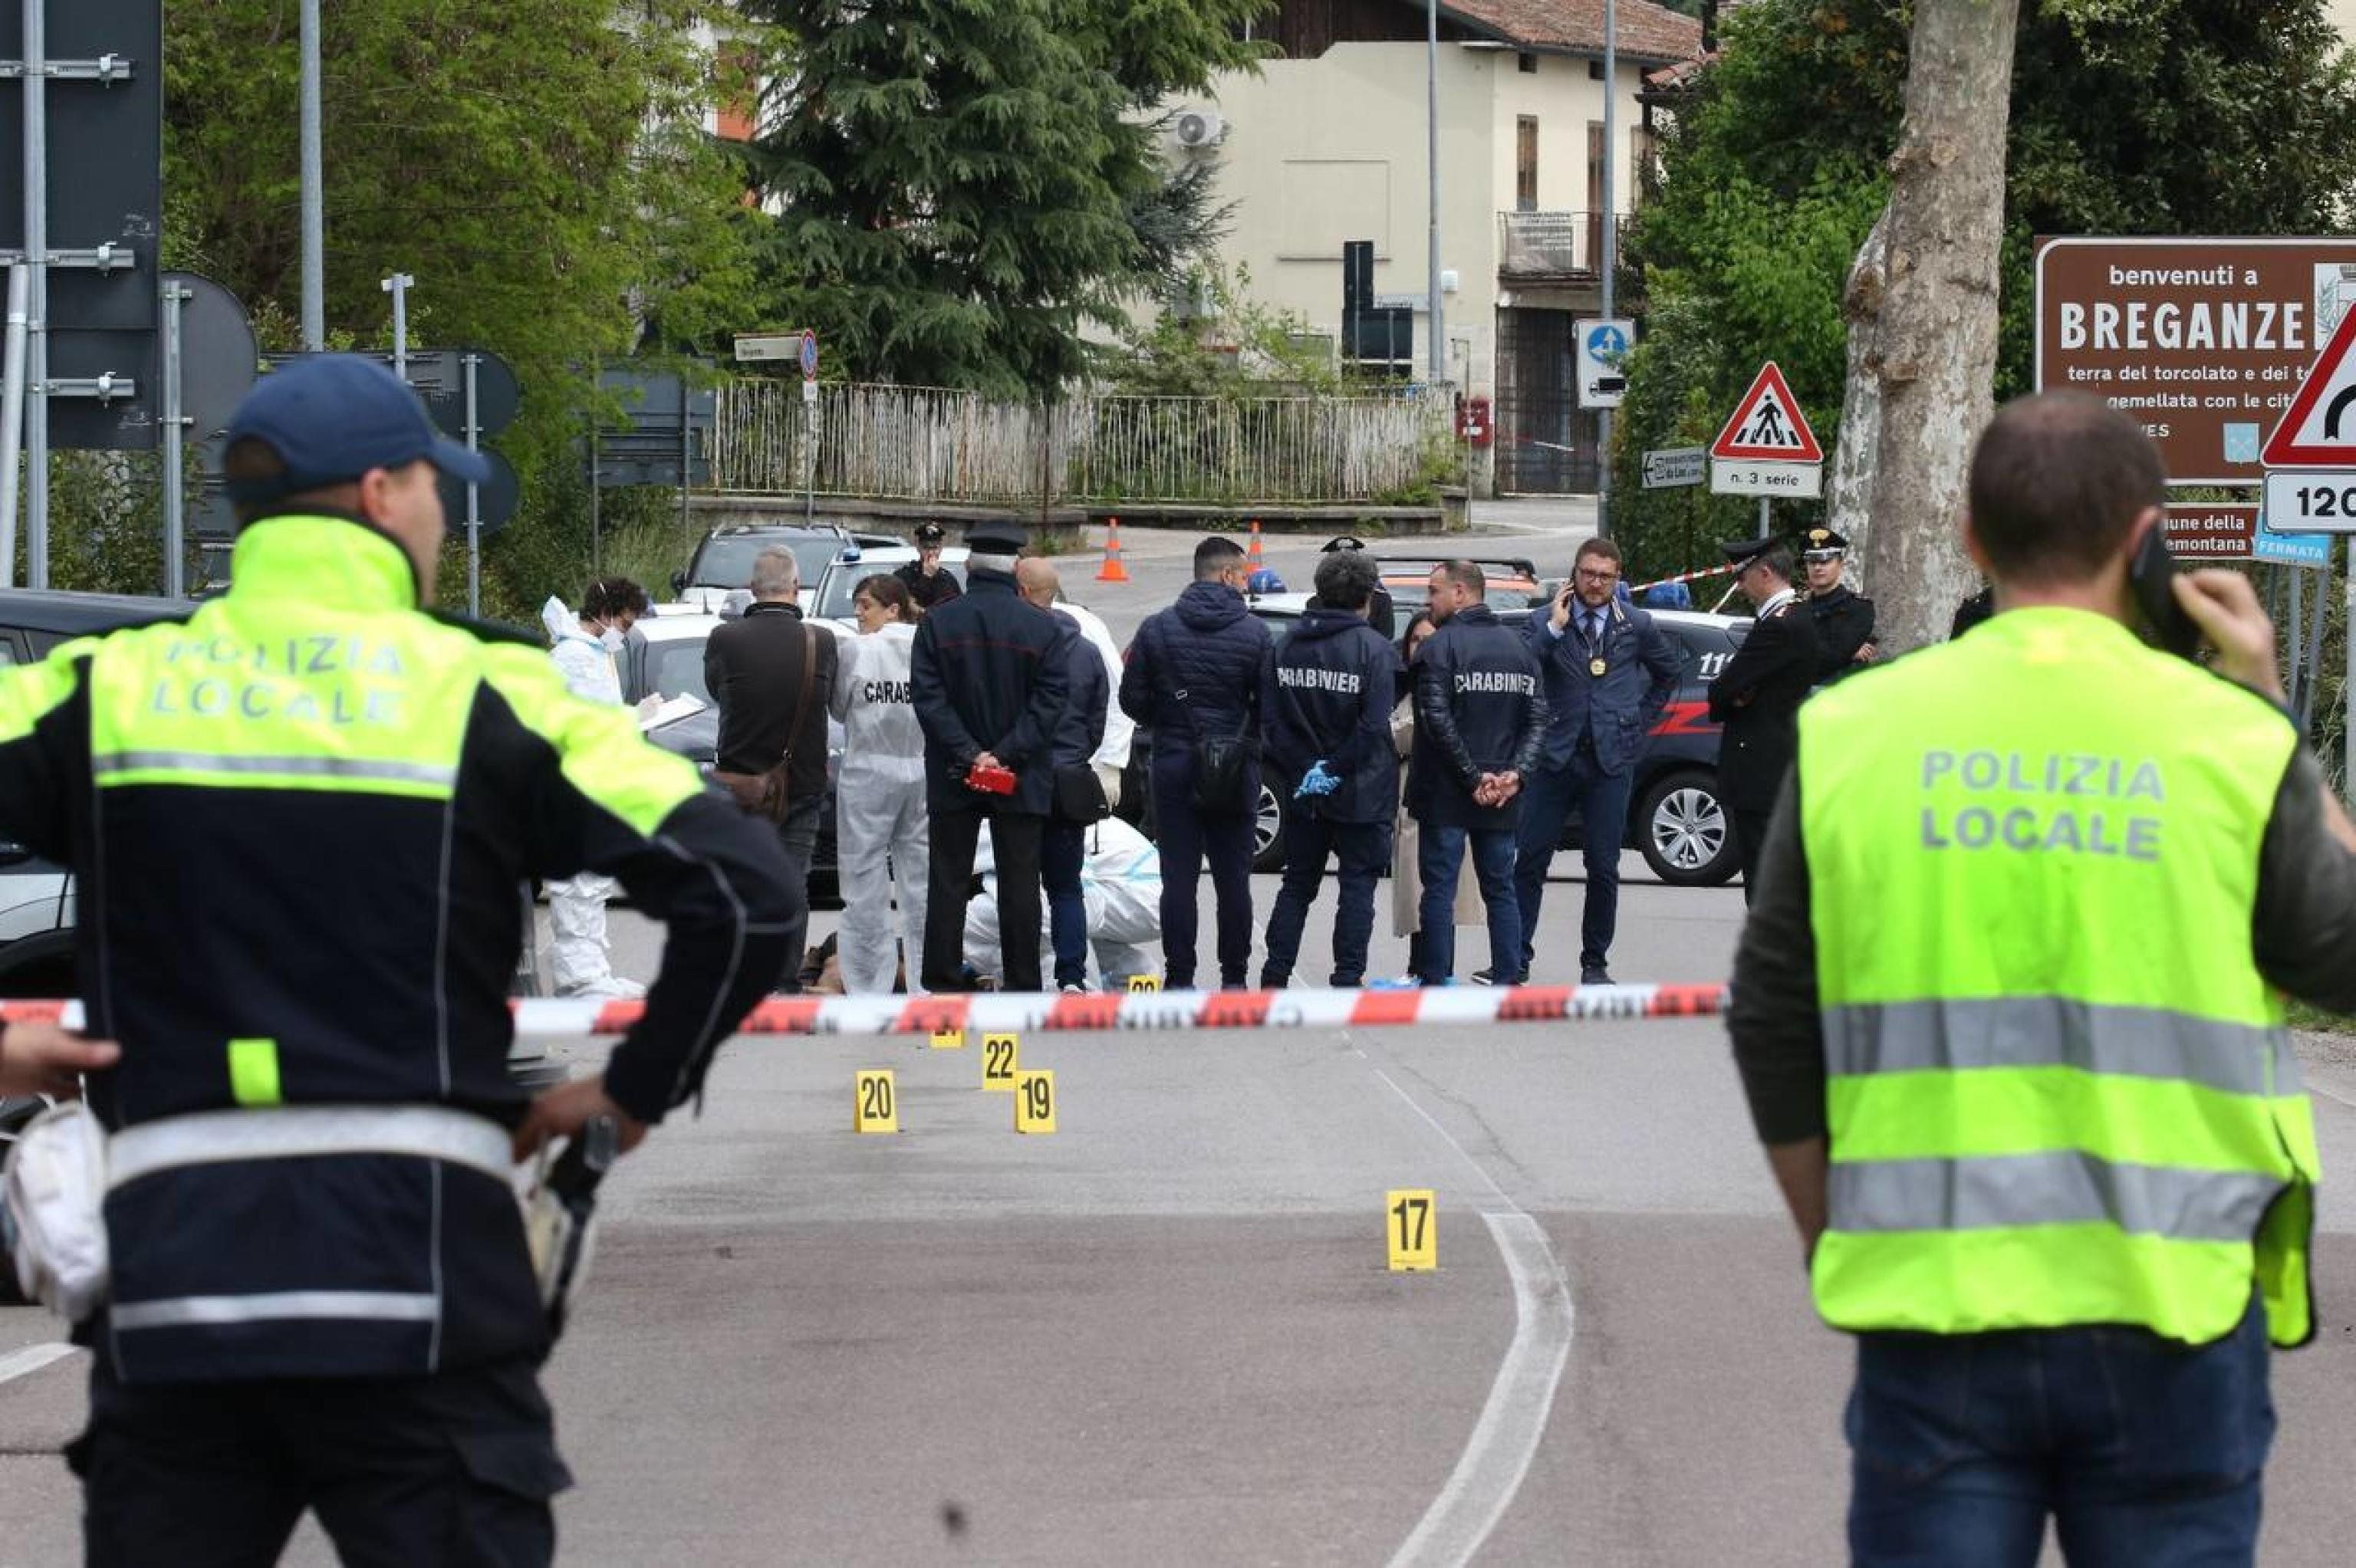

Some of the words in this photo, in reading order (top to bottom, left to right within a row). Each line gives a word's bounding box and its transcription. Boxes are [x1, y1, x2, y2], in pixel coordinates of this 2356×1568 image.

[2110, 265, 2234, 286] benvenuti
[2245, 270, 2258, 286] a
[2061, 303, 2305, 350] BREGANZE
[2068, 367, 2112, 381] terra
[2119, 366, 2147, 381] del
[2154, 366, 2238, 381] torcolato
[2245, 370, 2256, 381] e
[2262, 366, 2289, 380] dei
[2108, 392, 2198, 409] gemellata
[2205, 396, 2237, 409] con
[2245, 393, 2260, 409] le
[1749, 472, 1759, 485] 3
[1765, 474, 1799, 486] serie
[2204, 514, 2245, 531] della
[2258, 540, 2325, 559] FERMATA
[1922, 750, 2165, 804] POLIZIA
[1920, 805, 2161, 863] LOCALE
[986, 1040, 1013, 1079] 22
[861, 1077, 891, 1119] 20
[1021, 1077, 1051, 1119] 19
[1393, 1198, 1430, 1251] 17
